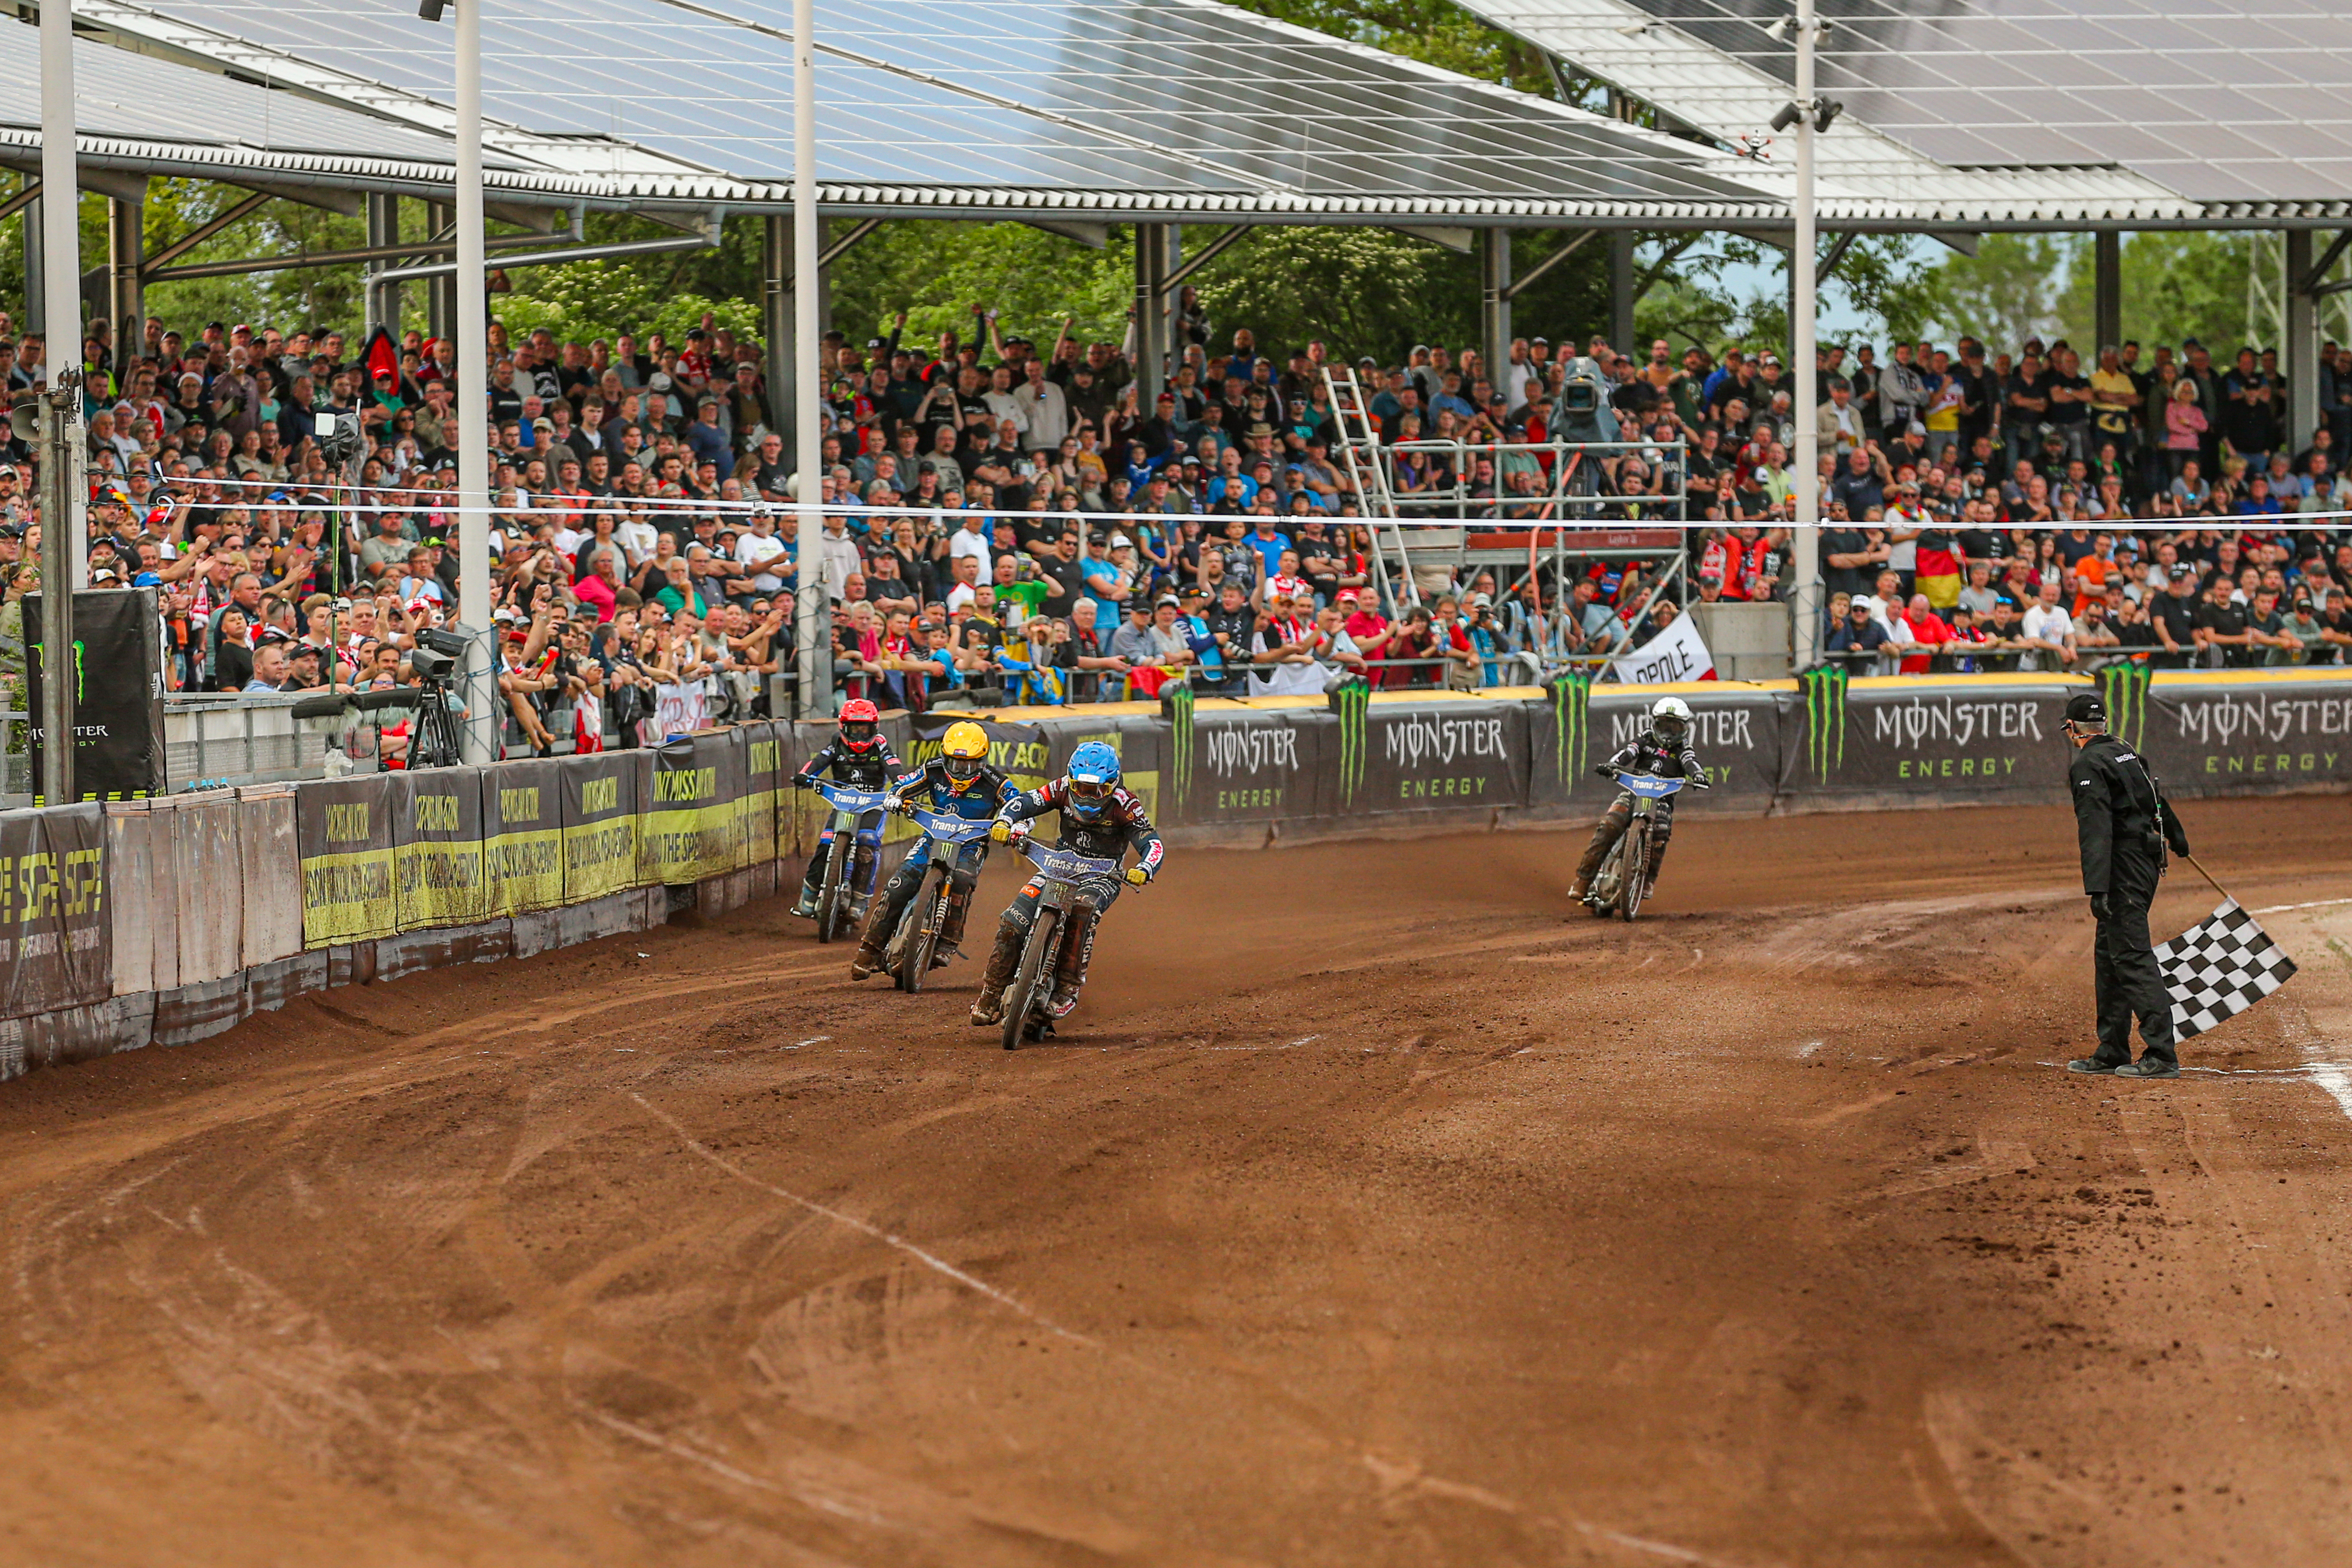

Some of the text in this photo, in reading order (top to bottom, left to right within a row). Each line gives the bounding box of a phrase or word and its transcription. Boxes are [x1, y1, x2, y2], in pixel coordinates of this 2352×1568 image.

[1874, 695, 2043, 750] MONSTER
[1207, 720, 1299, 779] MONSTER
[1385, 711, 1507, 769] MONSTER
[1898, 757, 2016, 778] ENERGY
[2205, 752, 2338, 774] ENERGY
[1400, 776, 1486, 799] ENERGY
[1633, 779, 1653, 790] Trans
[833, 792, 857, 804] Trans
[1218, 787, 1283, 809] ENERGY
[931, 818, 956, 832] Trans
[1043, 854, 1073, 871] Trans
